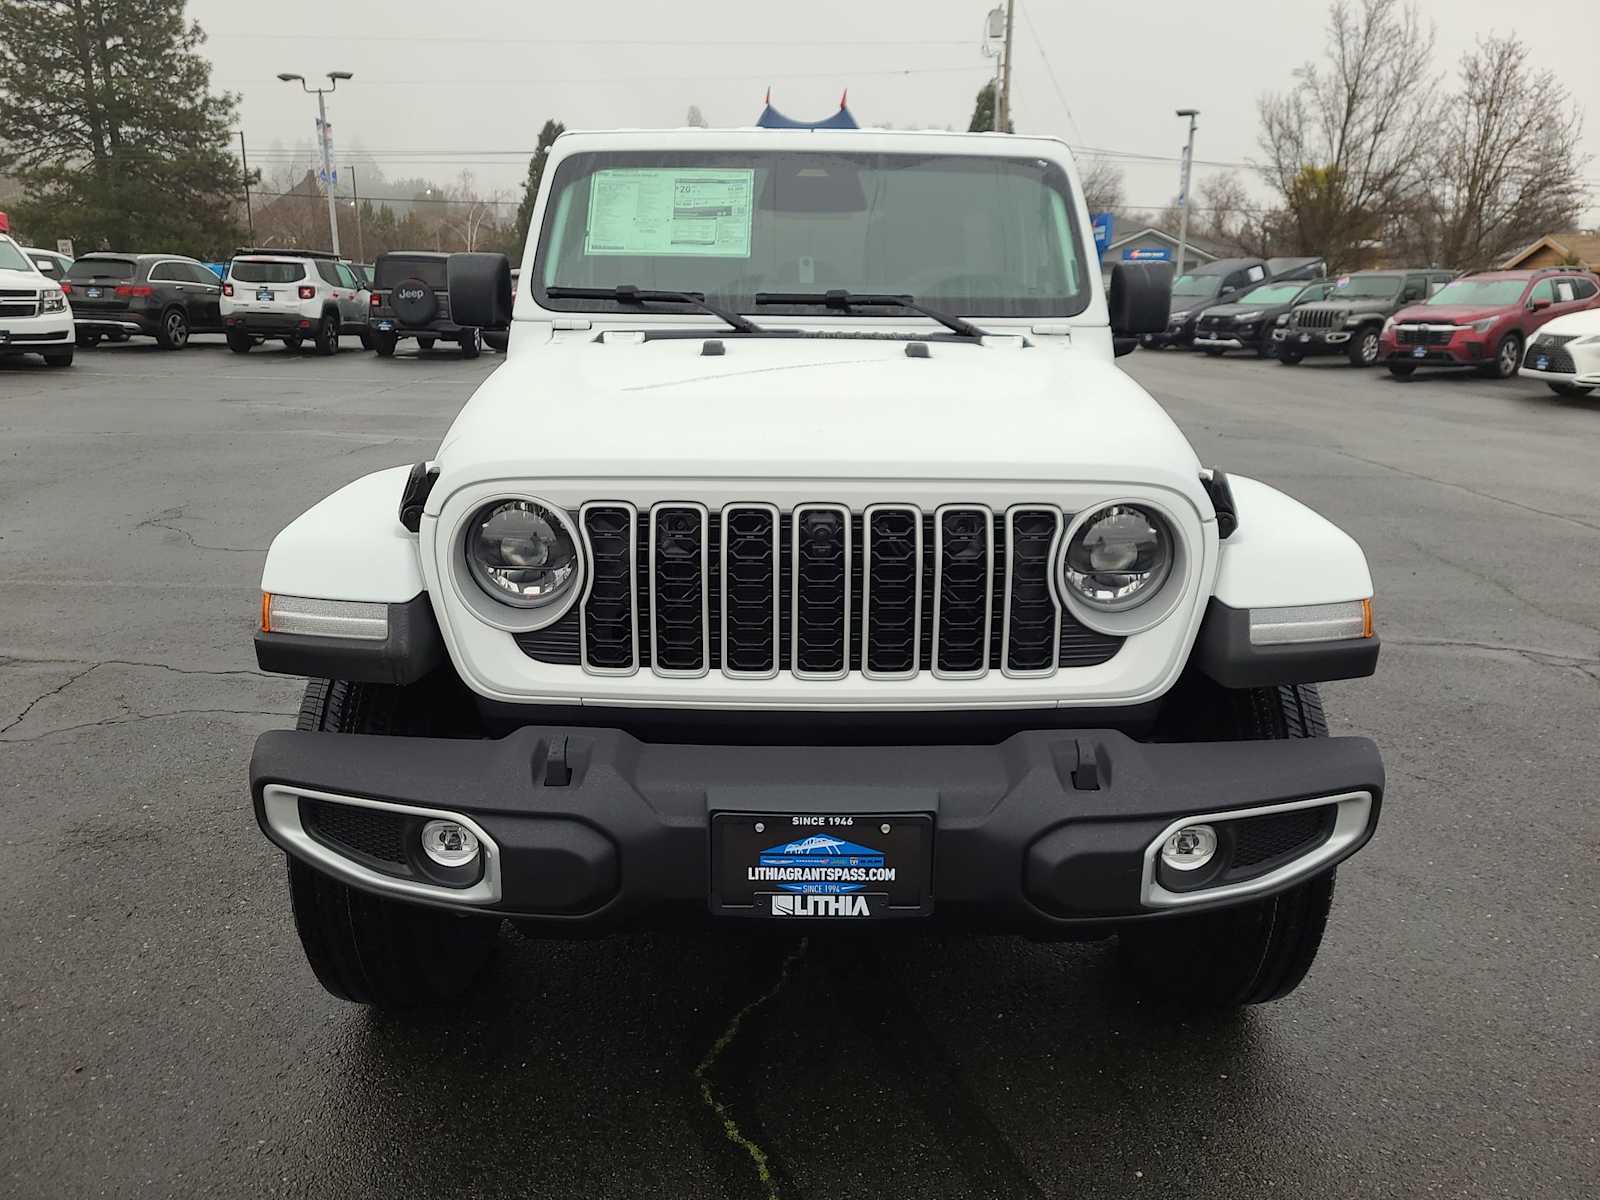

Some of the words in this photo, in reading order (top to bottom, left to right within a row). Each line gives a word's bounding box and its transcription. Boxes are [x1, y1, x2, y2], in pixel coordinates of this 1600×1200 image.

[399, 288, 424, 300] Jeep
[792, 816, 825, 826] SINCE
[828, 816, 854, 826] 1946
[747, 867, 896, 881] LITHIAGRANTSPASS.COM
[802, 884, 823, 893] SINCE
[824, 884, 841, 893] 1994
[794, 895, 871, 916] LITHIA
